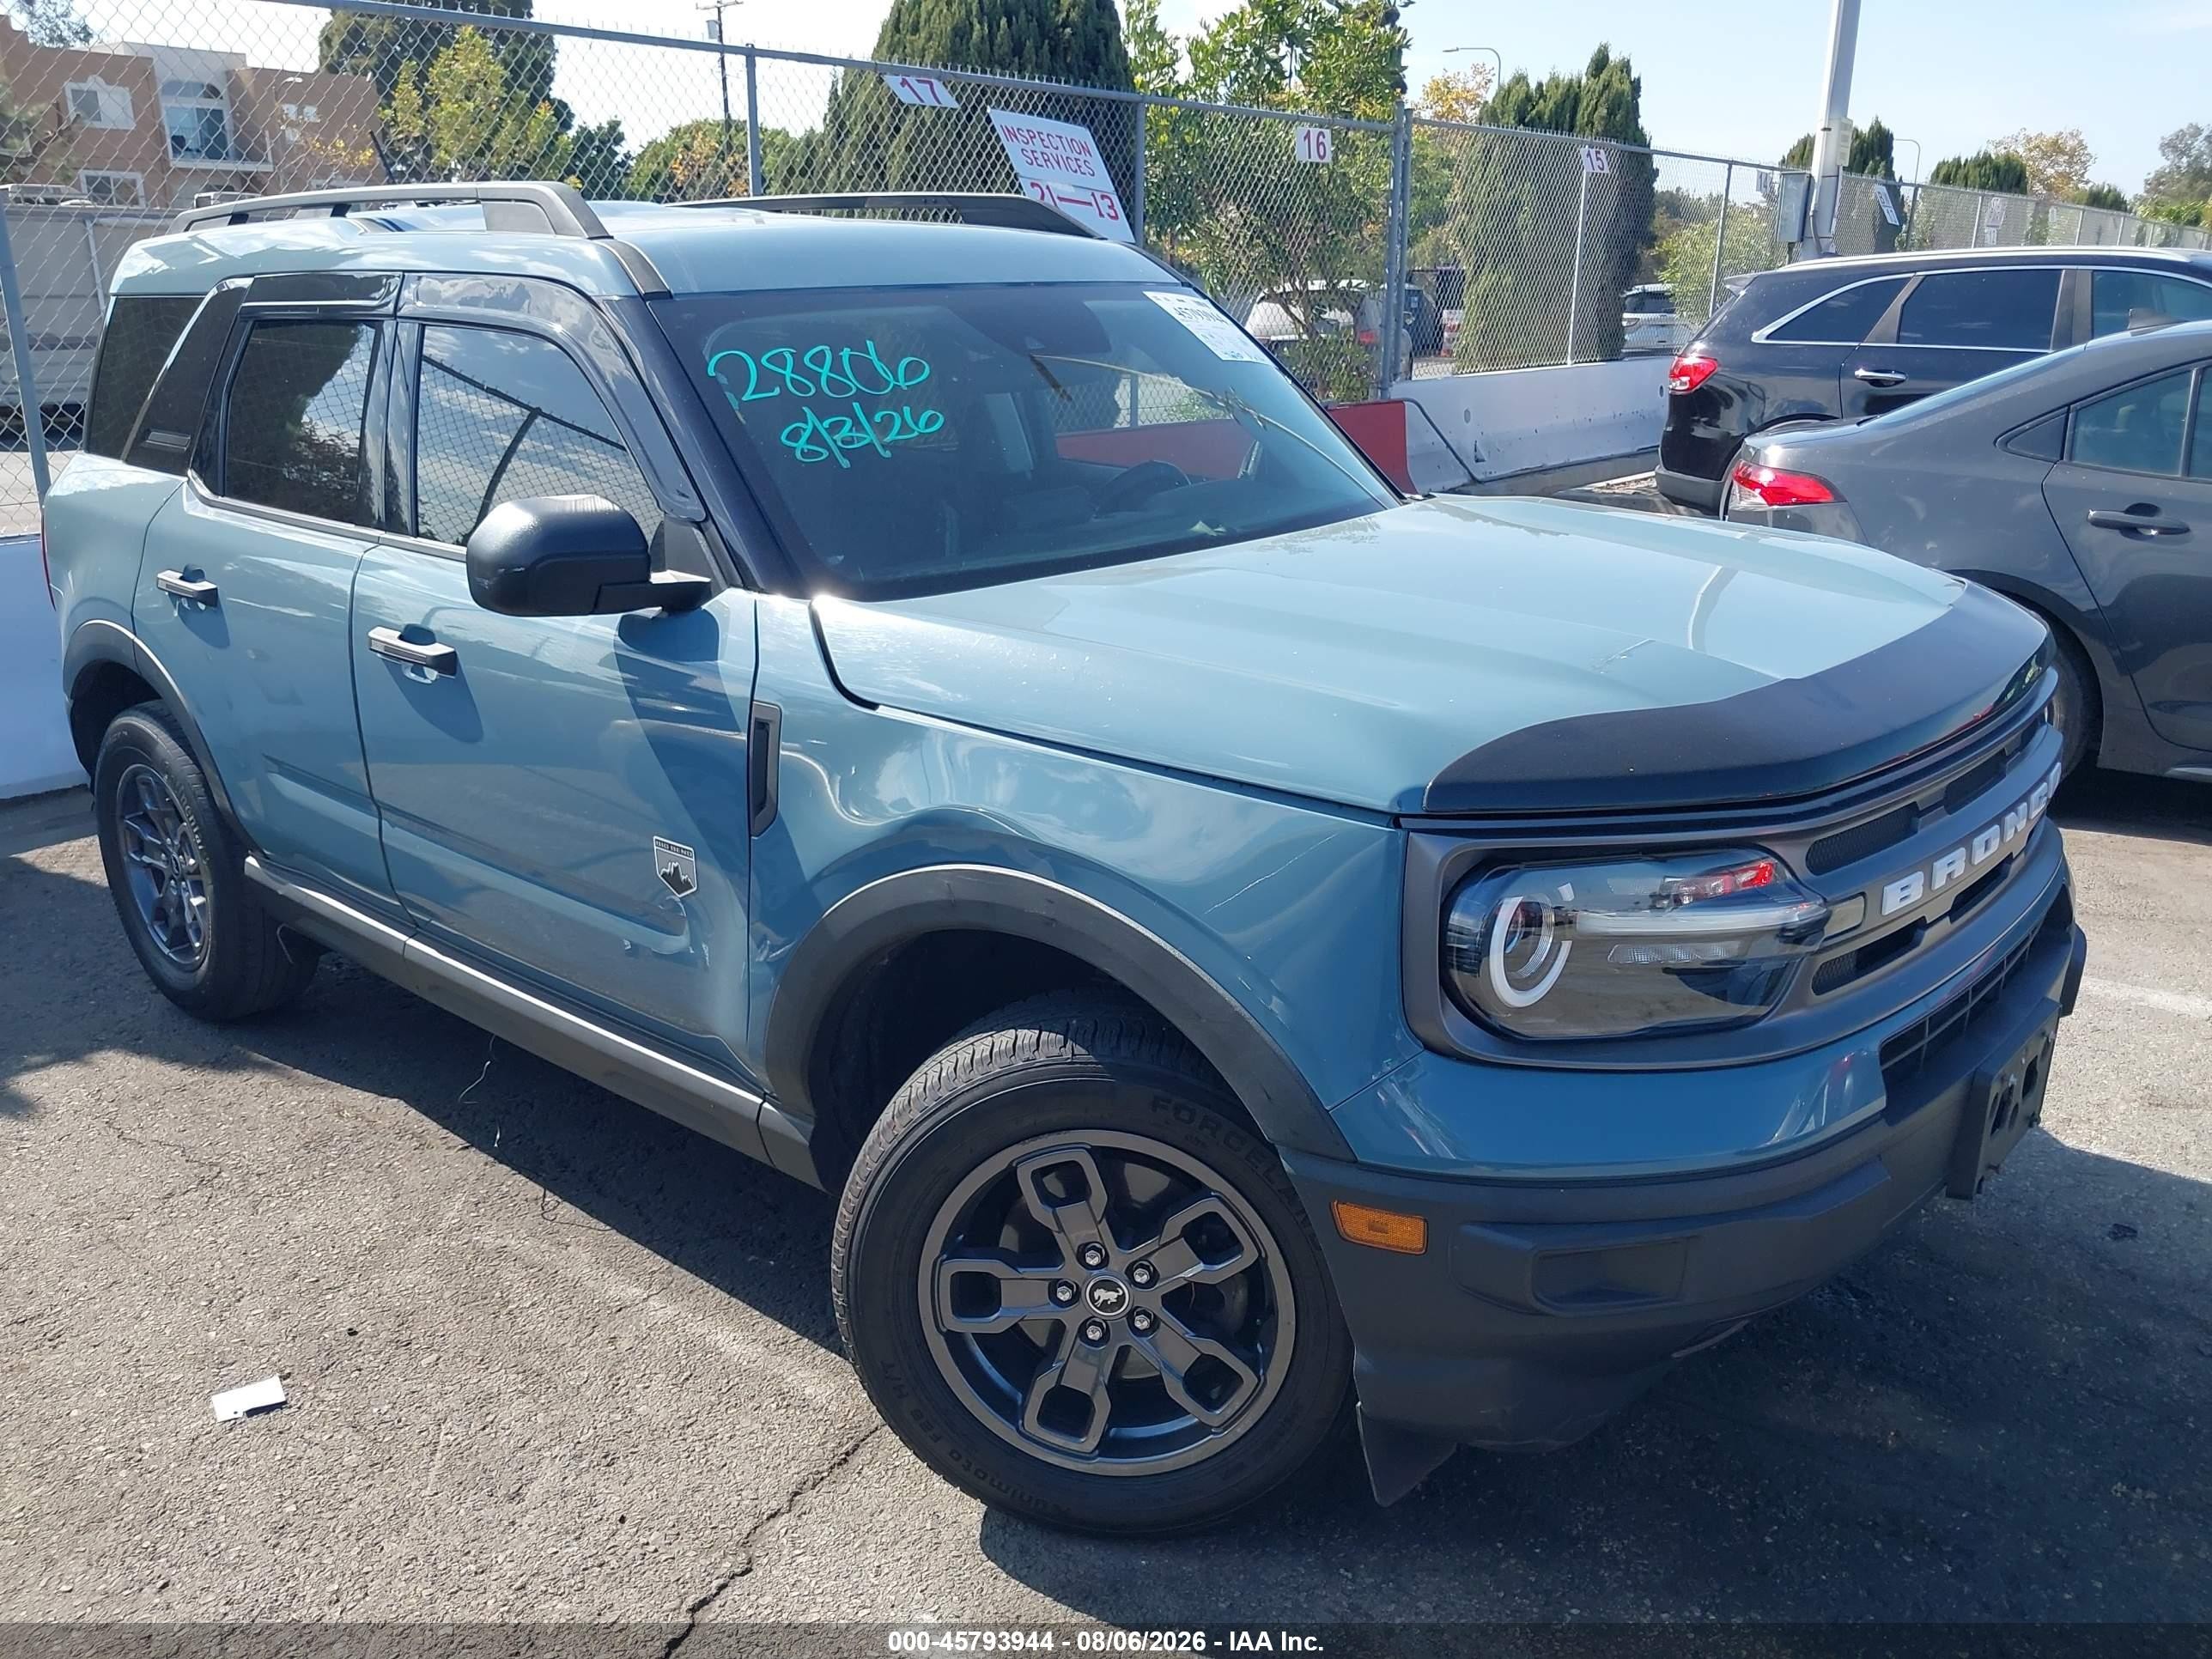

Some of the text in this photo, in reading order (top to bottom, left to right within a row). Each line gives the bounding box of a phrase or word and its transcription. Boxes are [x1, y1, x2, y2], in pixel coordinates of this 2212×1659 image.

[899, 76, 943, 106] 17
[1000, 124, 1093, 158] INSPECTION
[1303, 129, 1327, 161] 16
[1020, 148, 1096, 178] SERVICES
[1586, 149, 1605, 172] 15
[707, 339, 931, 398] 28806
